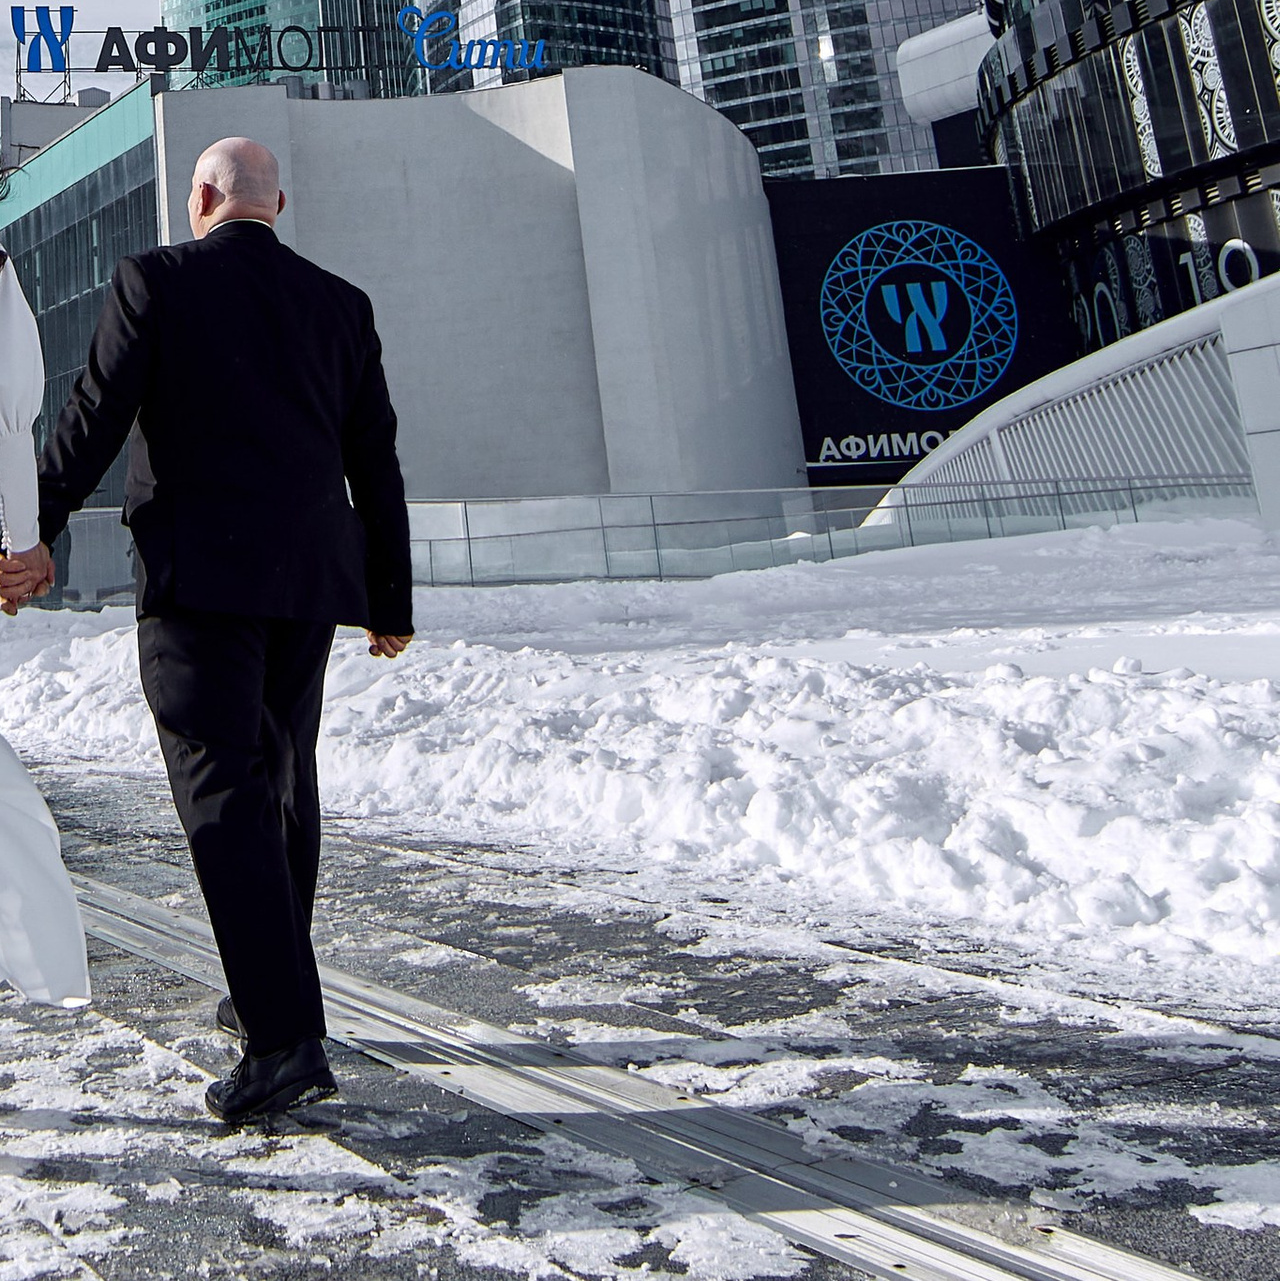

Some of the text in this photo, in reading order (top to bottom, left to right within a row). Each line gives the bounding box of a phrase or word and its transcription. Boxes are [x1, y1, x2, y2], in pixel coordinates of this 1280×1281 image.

[96, 5, 549, 72] АФИМОЛЛ Сити
[819, 430, 958, 460] АФИМО
